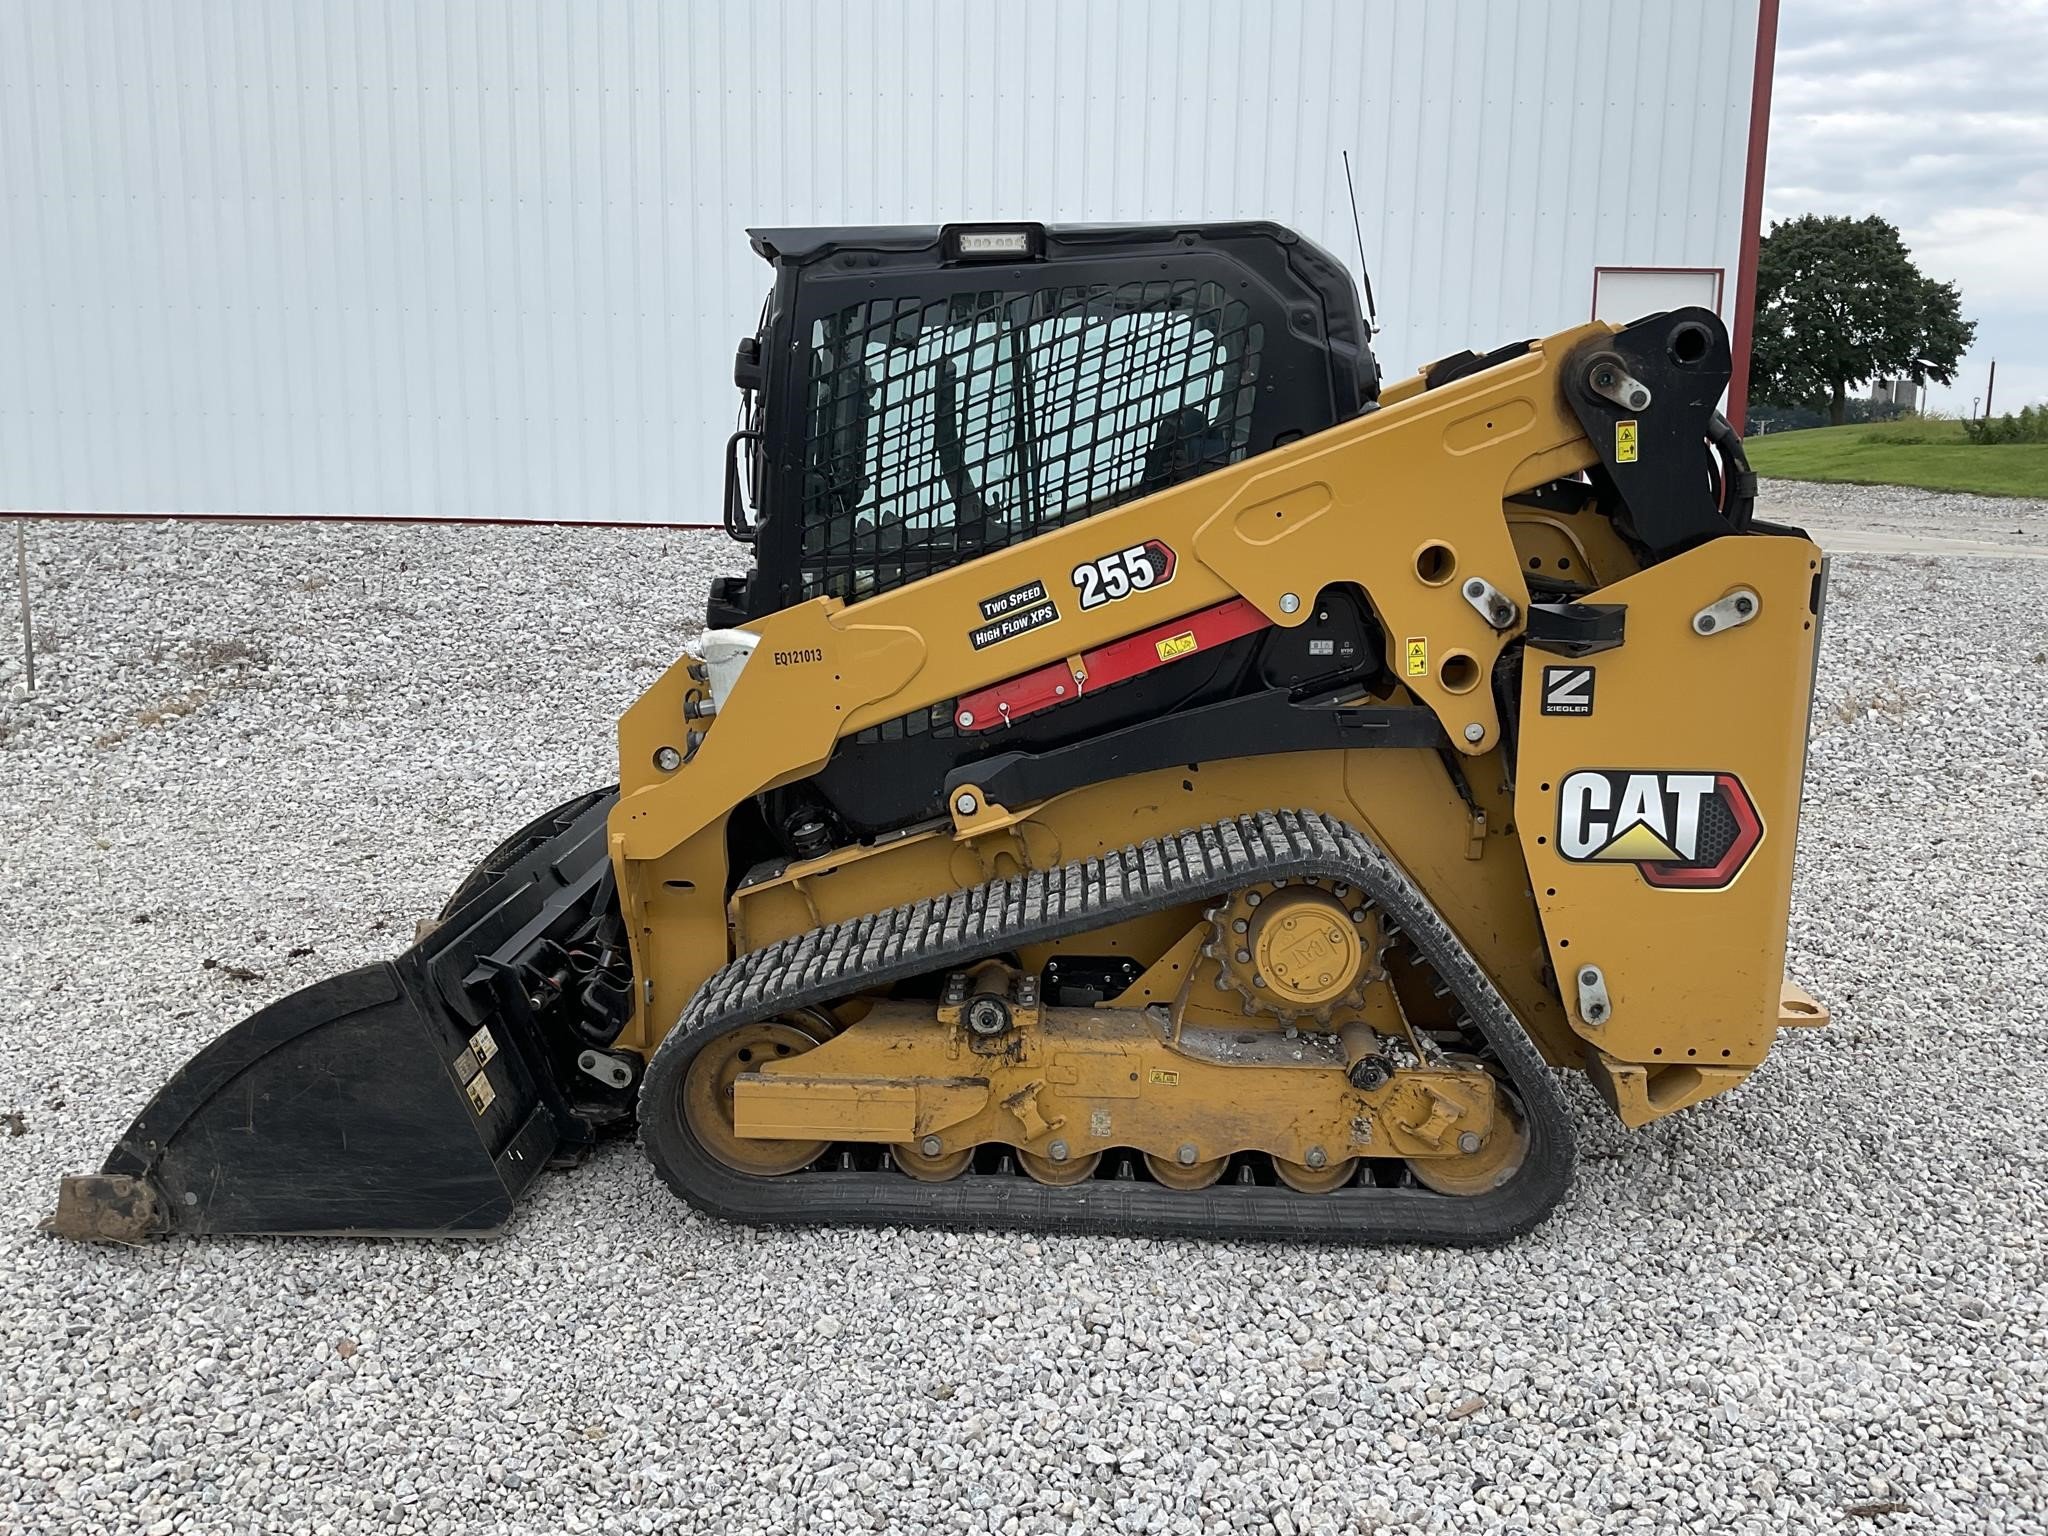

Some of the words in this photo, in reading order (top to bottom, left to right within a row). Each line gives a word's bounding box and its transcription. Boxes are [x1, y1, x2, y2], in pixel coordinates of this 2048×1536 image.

[1073, 545, 1155, 608] 255
[984, 601, 1008, 616] TWO
[1009, 586, 1041, 607] SPEED
[975, 626, 1001, 646] HIGH
[1002, 616, 1029, 636] FLOW
[1030, 605, 1053, 624] XPS
[774, 648, 823, 667] EQ121013
[1546, 705, 1589, 713] ZIEGLER
[1560, 771, 1716, 861] CAT
